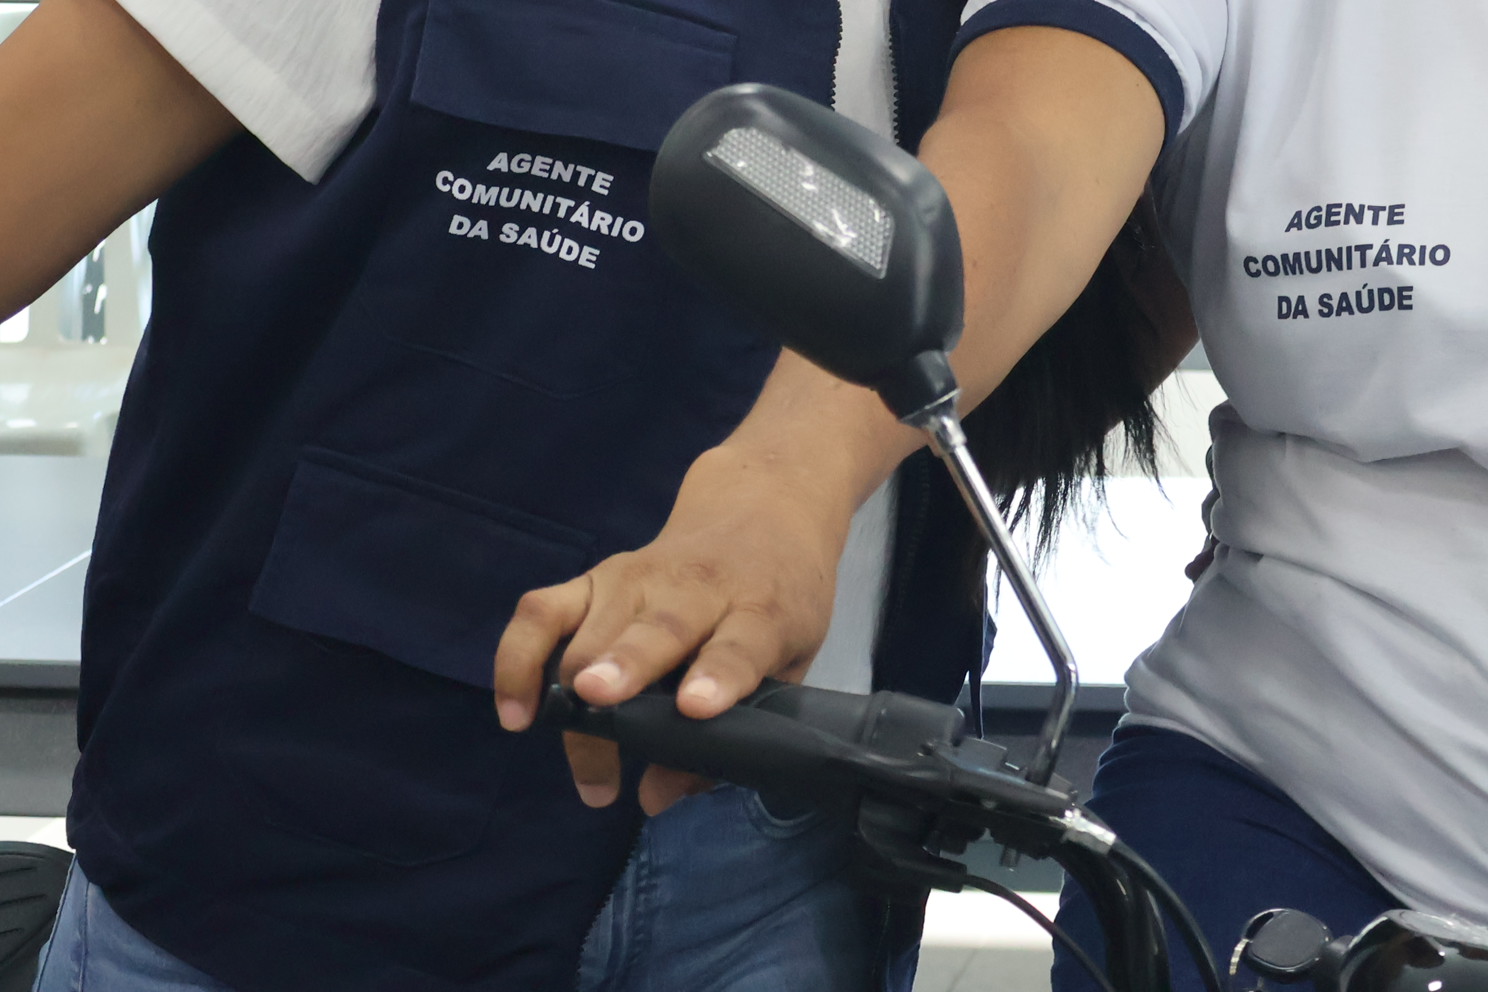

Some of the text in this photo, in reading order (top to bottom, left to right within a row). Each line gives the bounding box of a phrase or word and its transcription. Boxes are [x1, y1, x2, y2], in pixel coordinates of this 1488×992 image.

[486, 152, 615, 196] AGENTE
[435, 170, 646, 243] COMUNITÁRIO
[1284, 202, 1406, 233] AGENTE
[448, 214, 601, 270] DA SAÚDE
[1243, 238, 1452, 279] COMUNITÁRIO
[1277, 282, 1414, 321] DA SAÚDE
